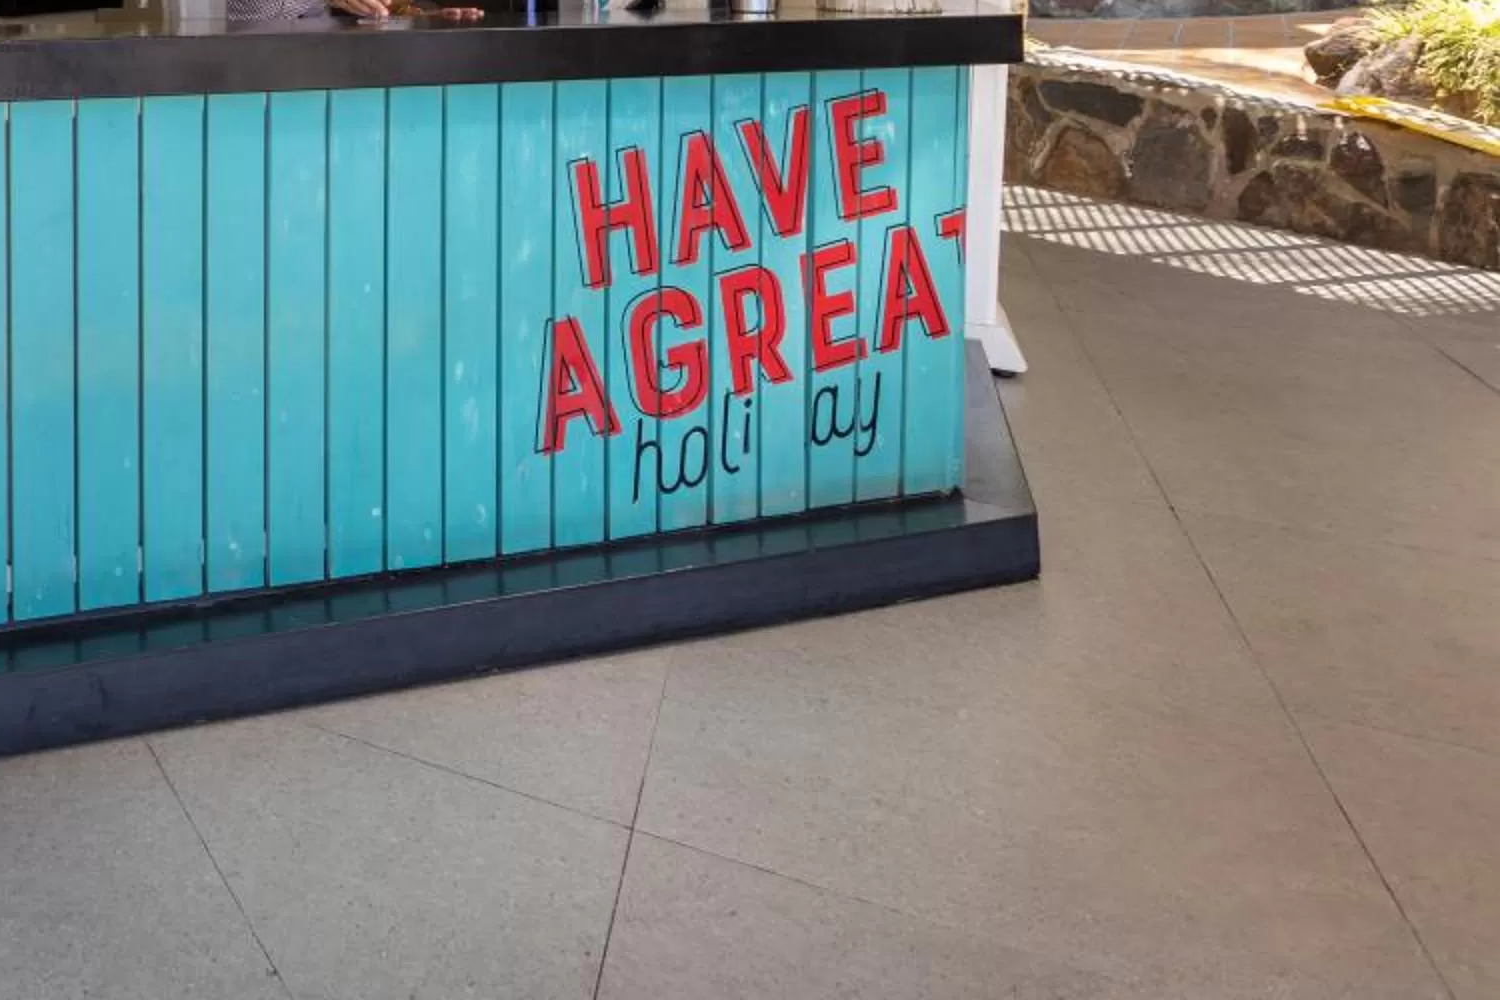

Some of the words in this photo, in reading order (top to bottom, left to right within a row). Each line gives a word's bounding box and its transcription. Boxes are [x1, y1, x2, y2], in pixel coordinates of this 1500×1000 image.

[567, 88, 899, 290] HAVE
[533, 314, 623, 457] A
[631, 370, 882, 505] holiay
